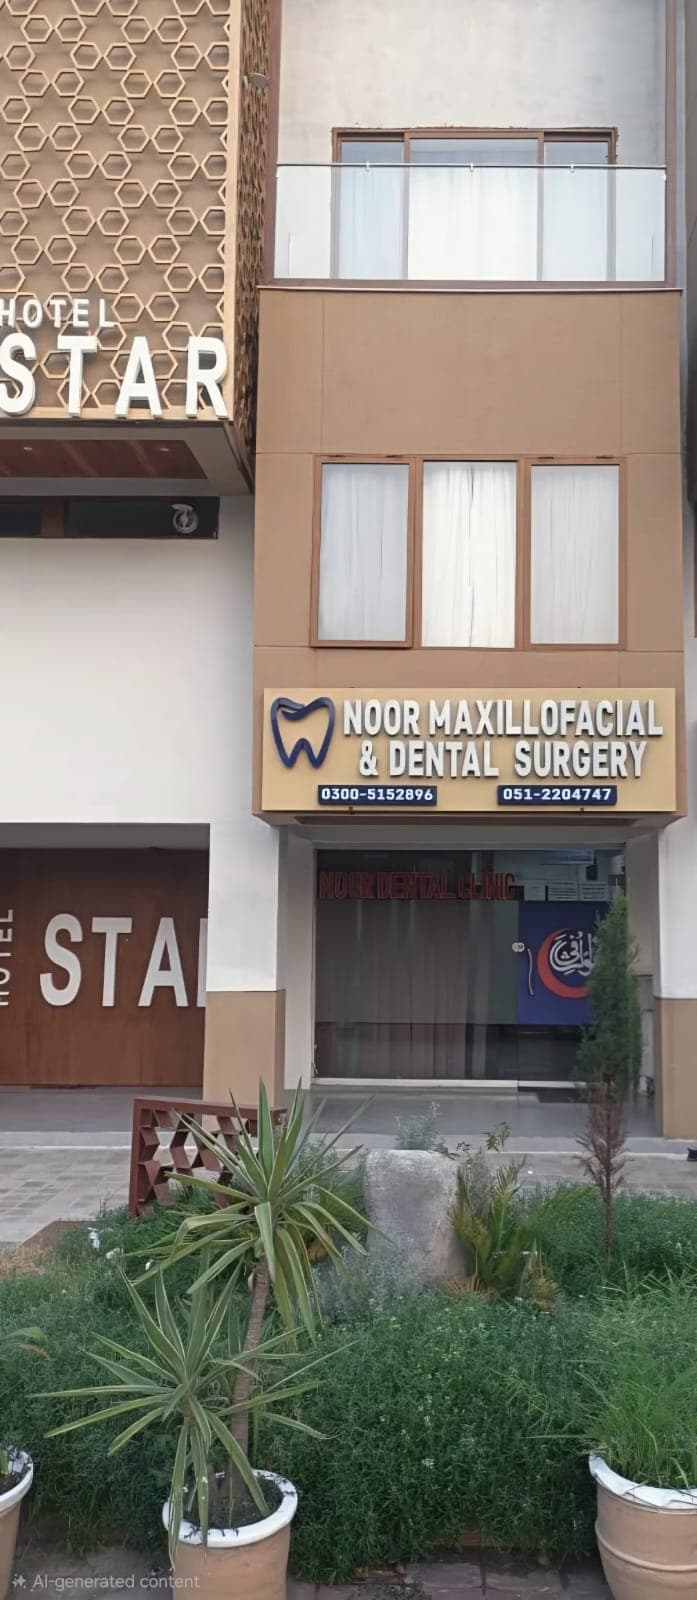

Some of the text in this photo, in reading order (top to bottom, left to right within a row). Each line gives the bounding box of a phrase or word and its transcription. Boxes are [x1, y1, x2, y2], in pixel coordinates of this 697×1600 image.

[0, 298, 115, 328] HOTEL
[0, 333, 228, 418] STAR
[343, 700, 663, 737] NOOR MAXILLOFACIAL
[359, 740, 648, 778] & DENTAL SURGERY
[321, 788, 433, 801] 0300-5152896
[503, 788, 612, 801] 051-2204747
[376, 872, 456, 899] DENTAL
[40, 913, 208, 1007] STA
